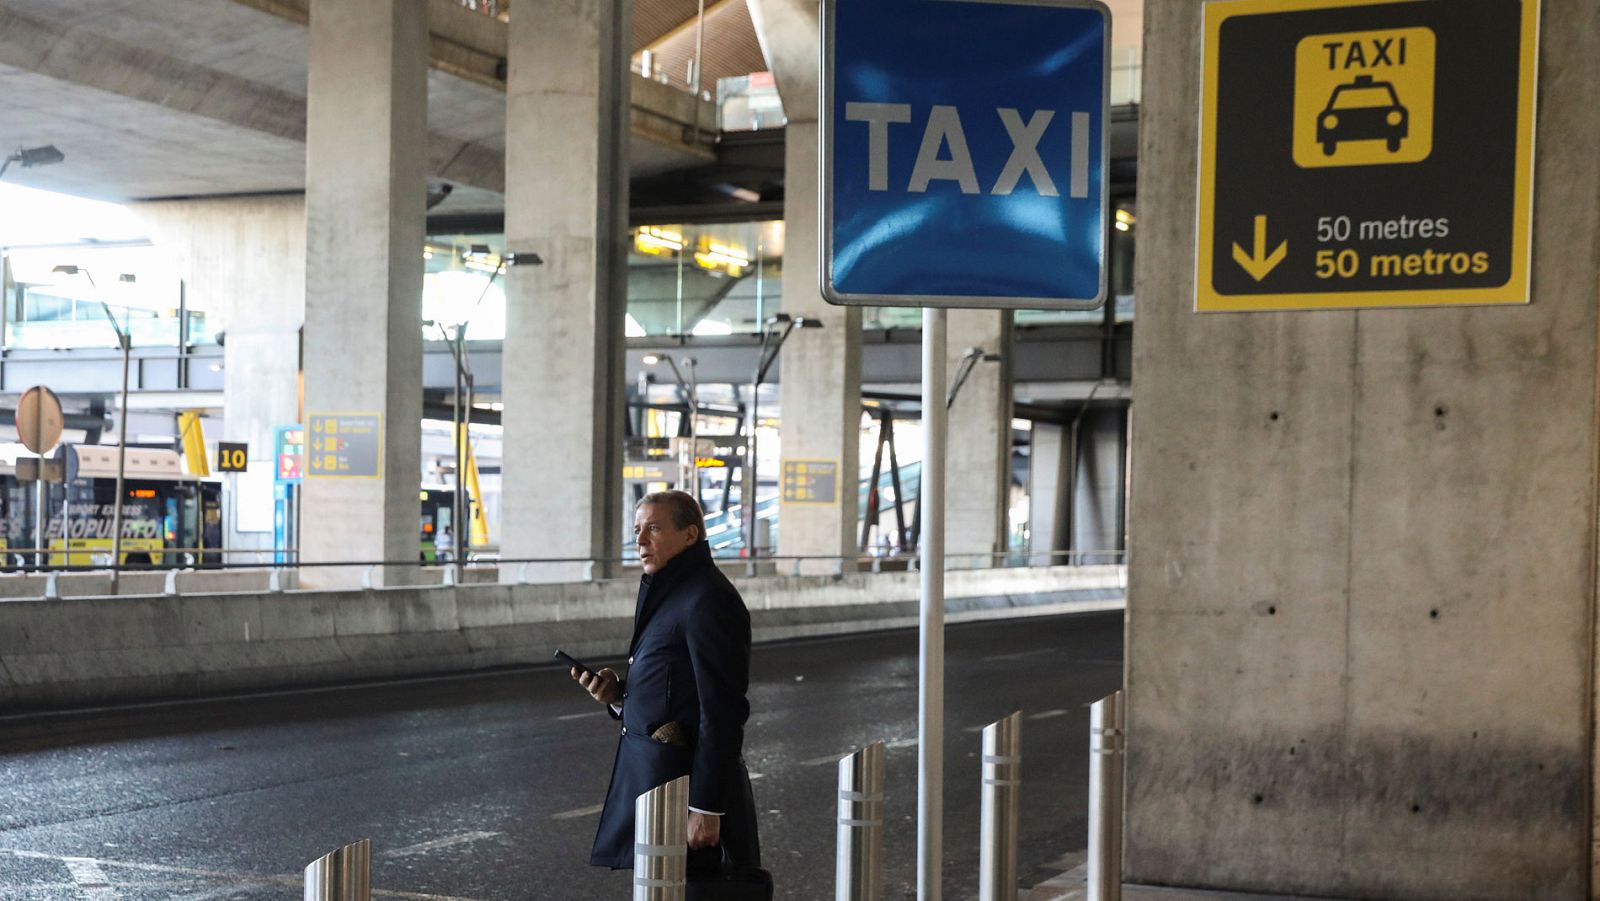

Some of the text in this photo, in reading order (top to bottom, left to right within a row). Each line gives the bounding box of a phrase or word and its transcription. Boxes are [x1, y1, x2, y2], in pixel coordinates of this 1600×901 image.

[1323, 37, 1406, 70] TAXI
[845, 101, 1090, 198] TAXI
[1317, 215, 1449, 242] 50 metres
[1315, 249, 1489, 279] 50 metros
[221, 449, 246, 468] 10
[60, 504, 142, 515] IRPORT EXRESS
